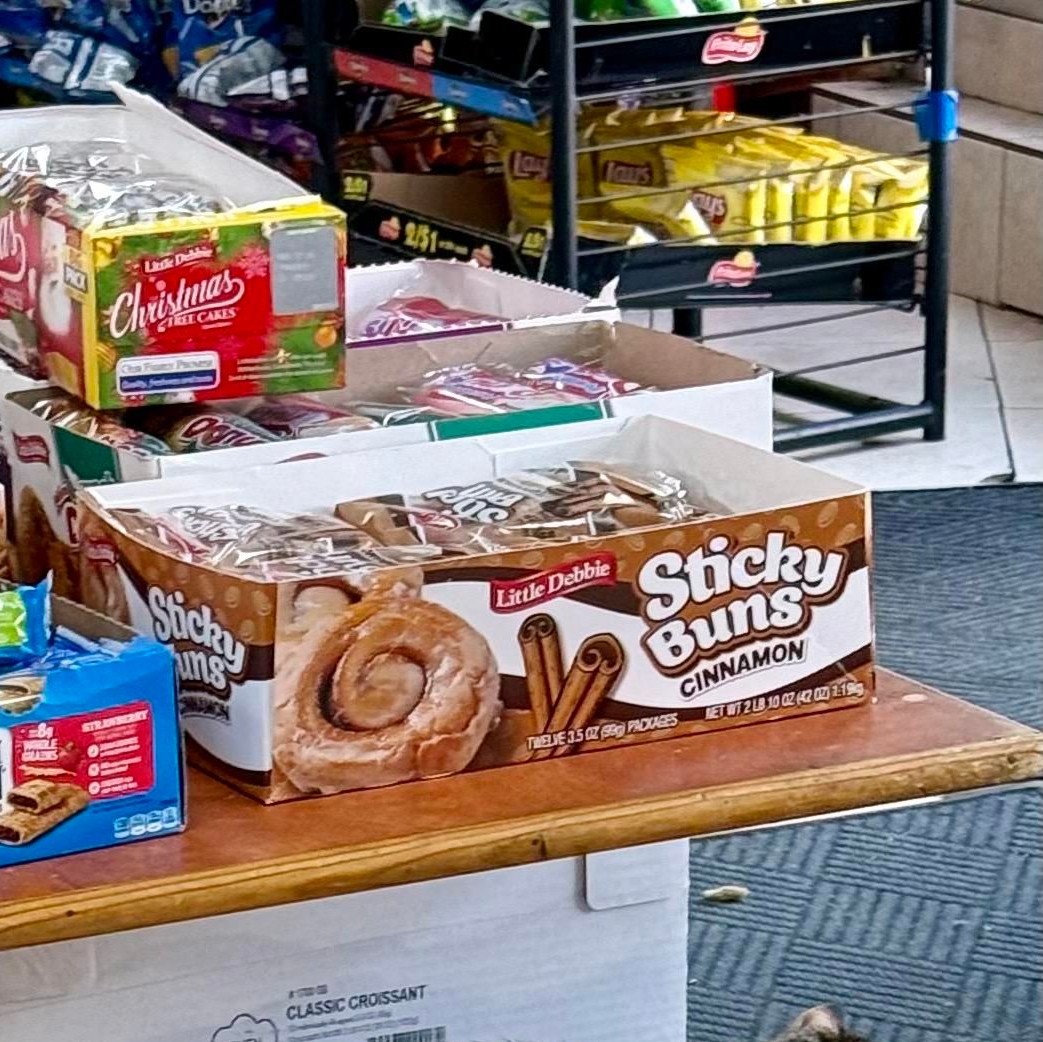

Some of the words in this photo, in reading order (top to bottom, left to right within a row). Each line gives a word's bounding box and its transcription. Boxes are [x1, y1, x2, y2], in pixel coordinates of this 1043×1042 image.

[109, 269, 245, 339] Christmas
[495, 582, 546, 610] Little
[547, 560, 612, 594] Debbie
[638, 532, 844, 622] Sticky
[148, 585, 246, 674] Sticky
[648, 586, 803, 669] Buns
[174, 649, 228, 690] uns
[679, 638, 805, 699] CINNAMON
[567, 728, 585, 744] 3.5
[585, 725, 600, 741] OZ
[627, 712, 679, 734] PACKAGES
[705, 704, 725, 720] NET
[726, 703, 742, 717] WT
[743, 701, 753, 714] 2
[753, 699, 766, 713] LB
[767, 695, 781, 709] 10
[781, 691, 796, 706] OZ
[286, 996, 346, 1021] CLASSIC
[347, 984, 427, 1011] CROISSANT
